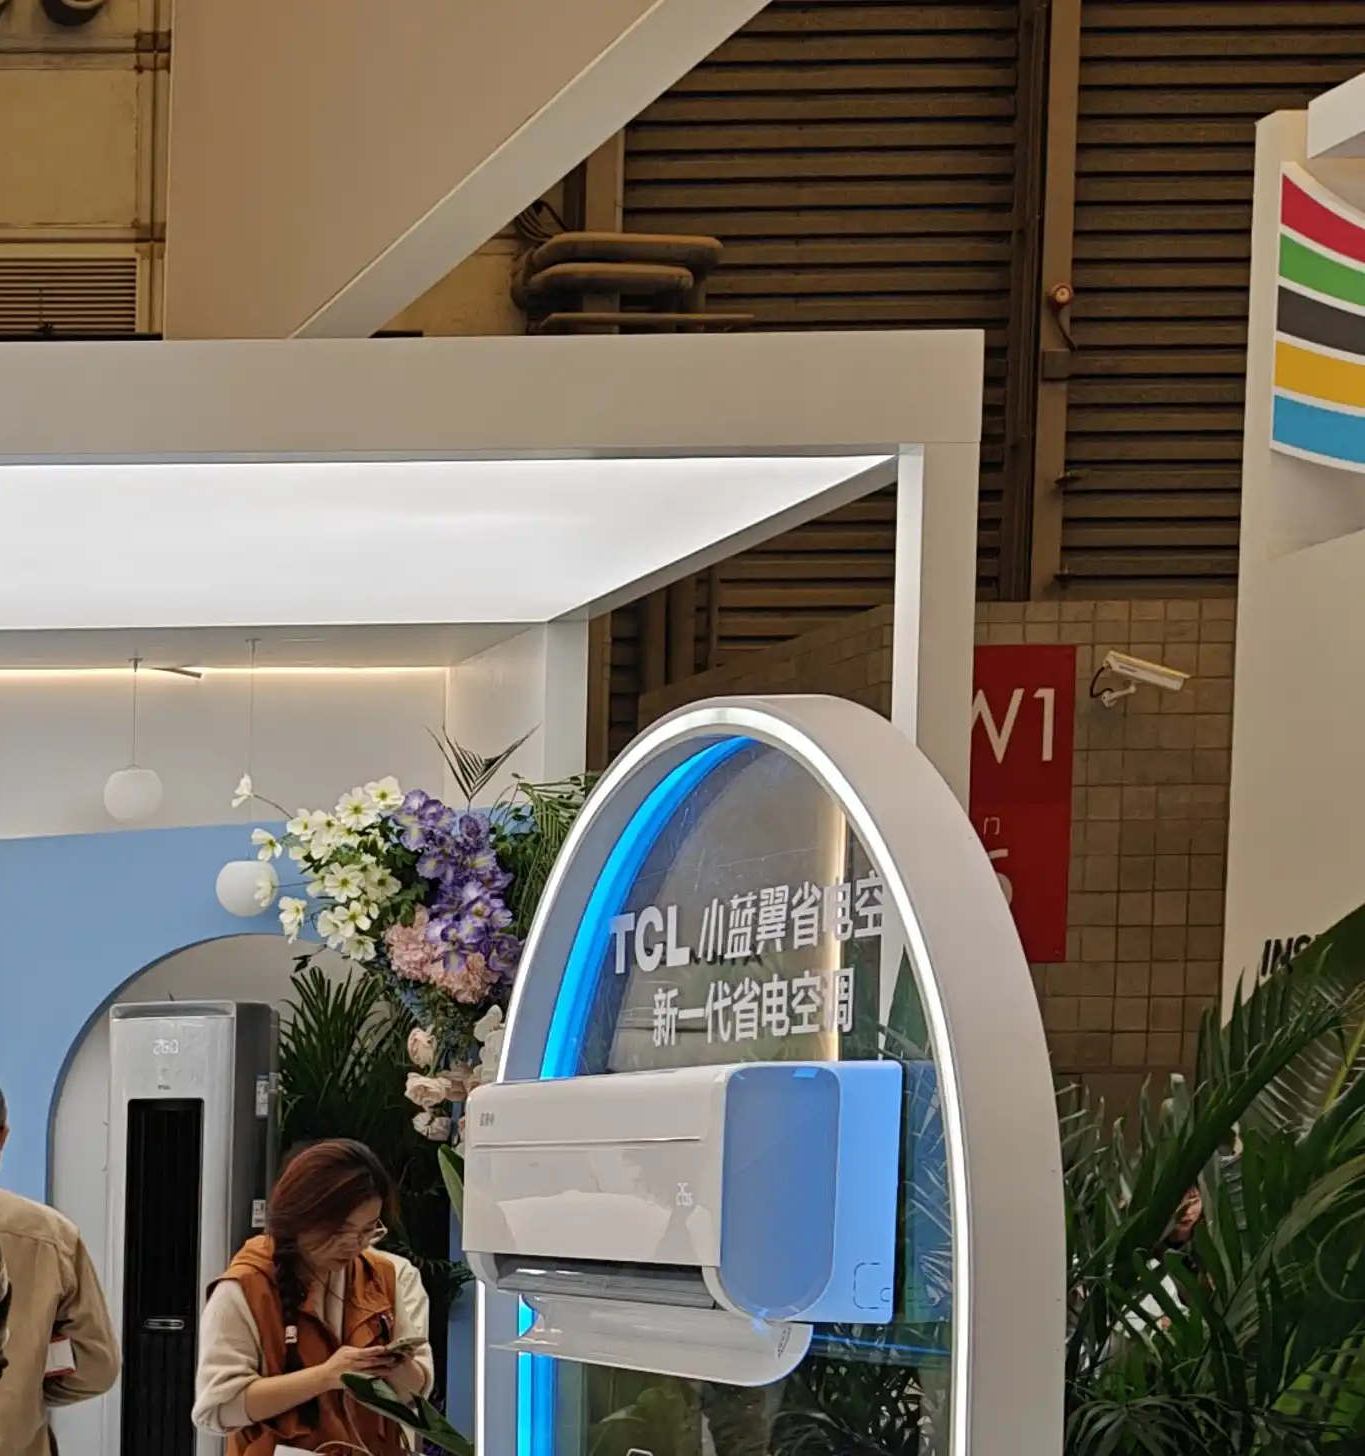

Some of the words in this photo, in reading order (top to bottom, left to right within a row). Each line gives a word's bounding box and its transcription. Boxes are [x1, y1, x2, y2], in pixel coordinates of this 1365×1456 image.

[609, 906, 690, 974] TCL
[652, 968, 855, 1047] 新一代省电空调
